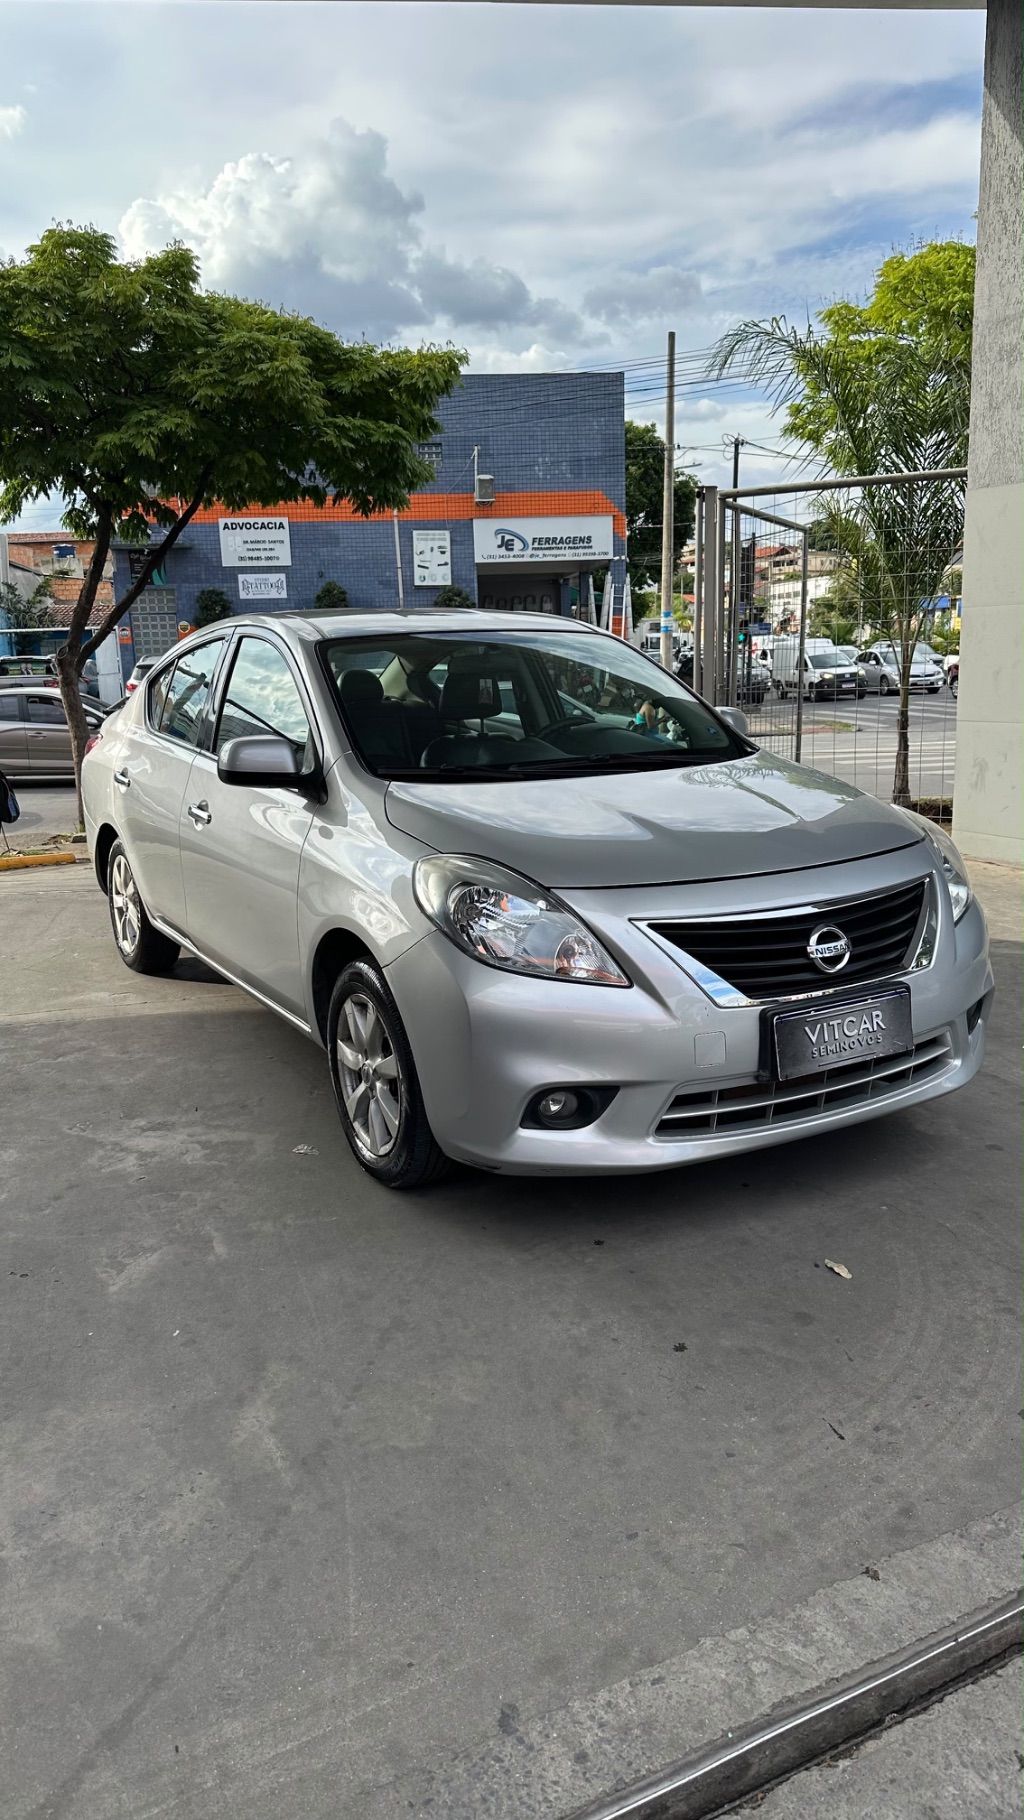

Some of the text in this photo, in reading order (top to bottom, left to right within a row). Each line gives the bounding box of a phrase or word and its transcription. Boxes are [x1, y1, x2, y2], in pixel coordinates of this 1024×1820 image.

[222, 522, 286, 530] ADVOCACIA
[497, 535, 514, 552] JE
[532, 536, 592, 546] FERRAGENS
[816, 943, 848, 956] NISSAN
[804, 1010, 886, 1045] VITCAR
[811, 1033, 883, 1059] SEMINOVOS
